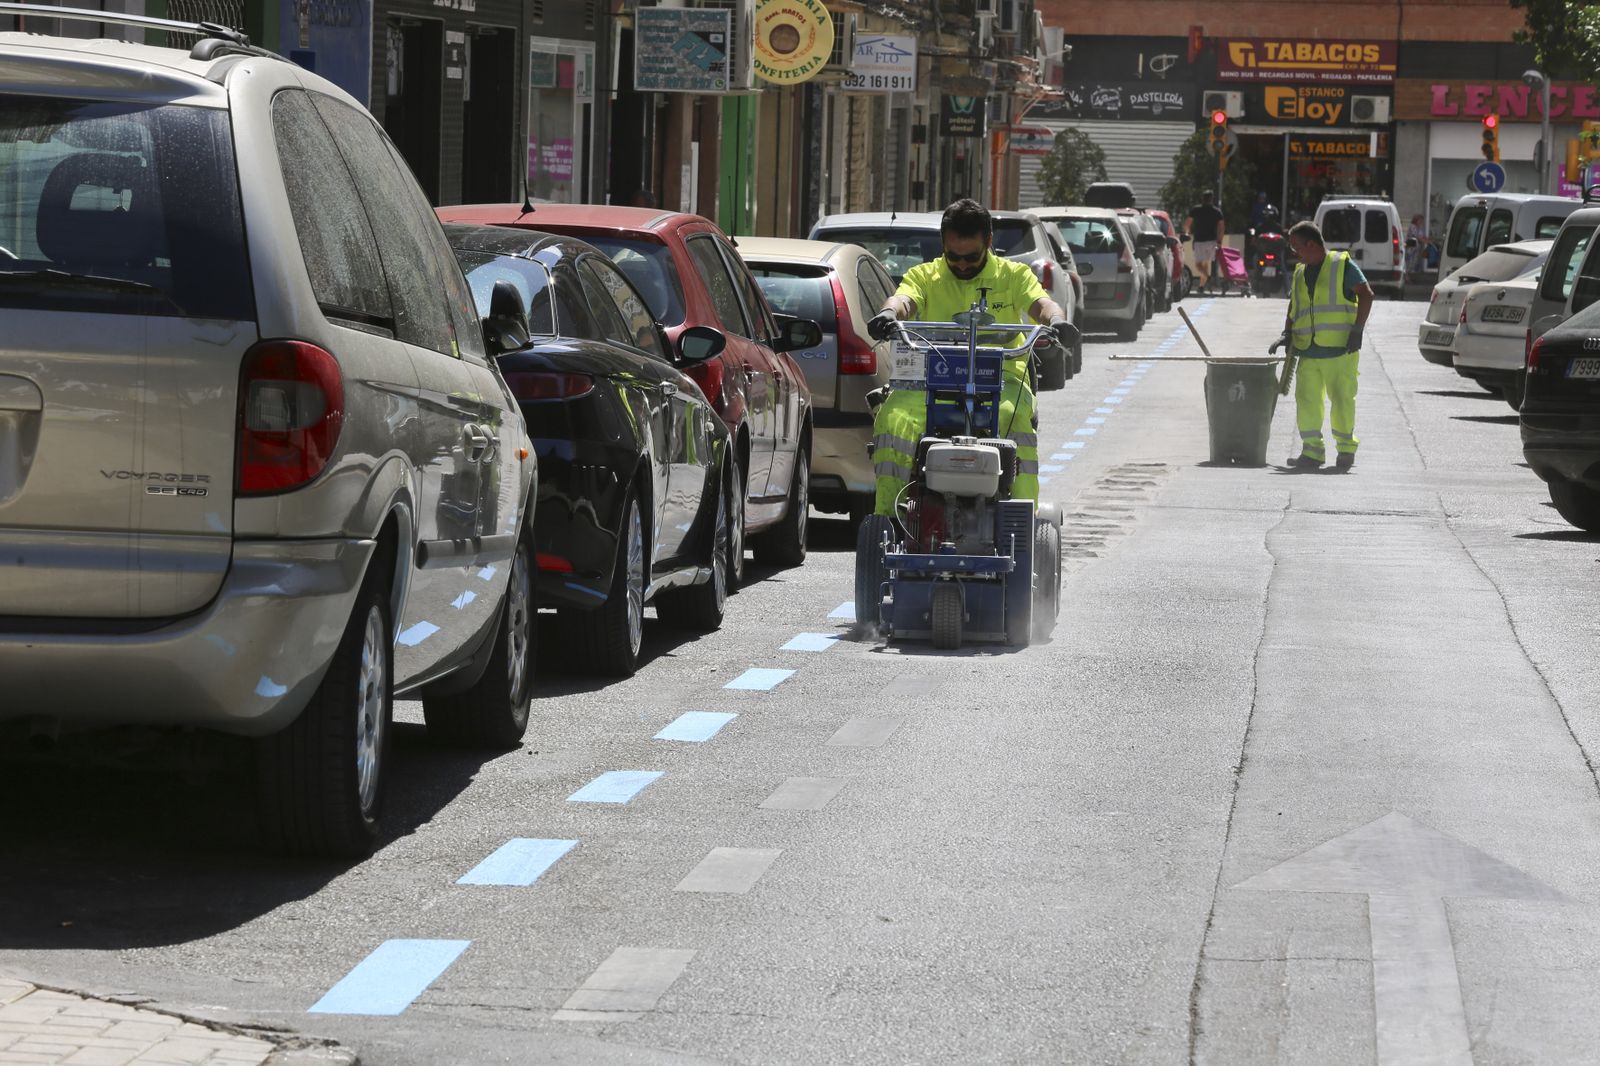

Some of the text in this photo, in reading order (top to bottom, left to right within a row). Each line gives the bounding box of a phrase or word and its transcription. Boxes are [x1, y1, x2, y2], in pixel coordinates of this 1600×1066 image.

[1264, 42, 1380, 63] TABACOS
[753, 55, 822, 78] ONFITERIA
[1299, 88, 1345, 97] ESTANCO
[1278, 97, 1343, 125] Eloy
[801, 351, 828, 360] C4
[100, 470, 211, 483] VOYAGER
[147, 486, 206, 496] SE CRD
